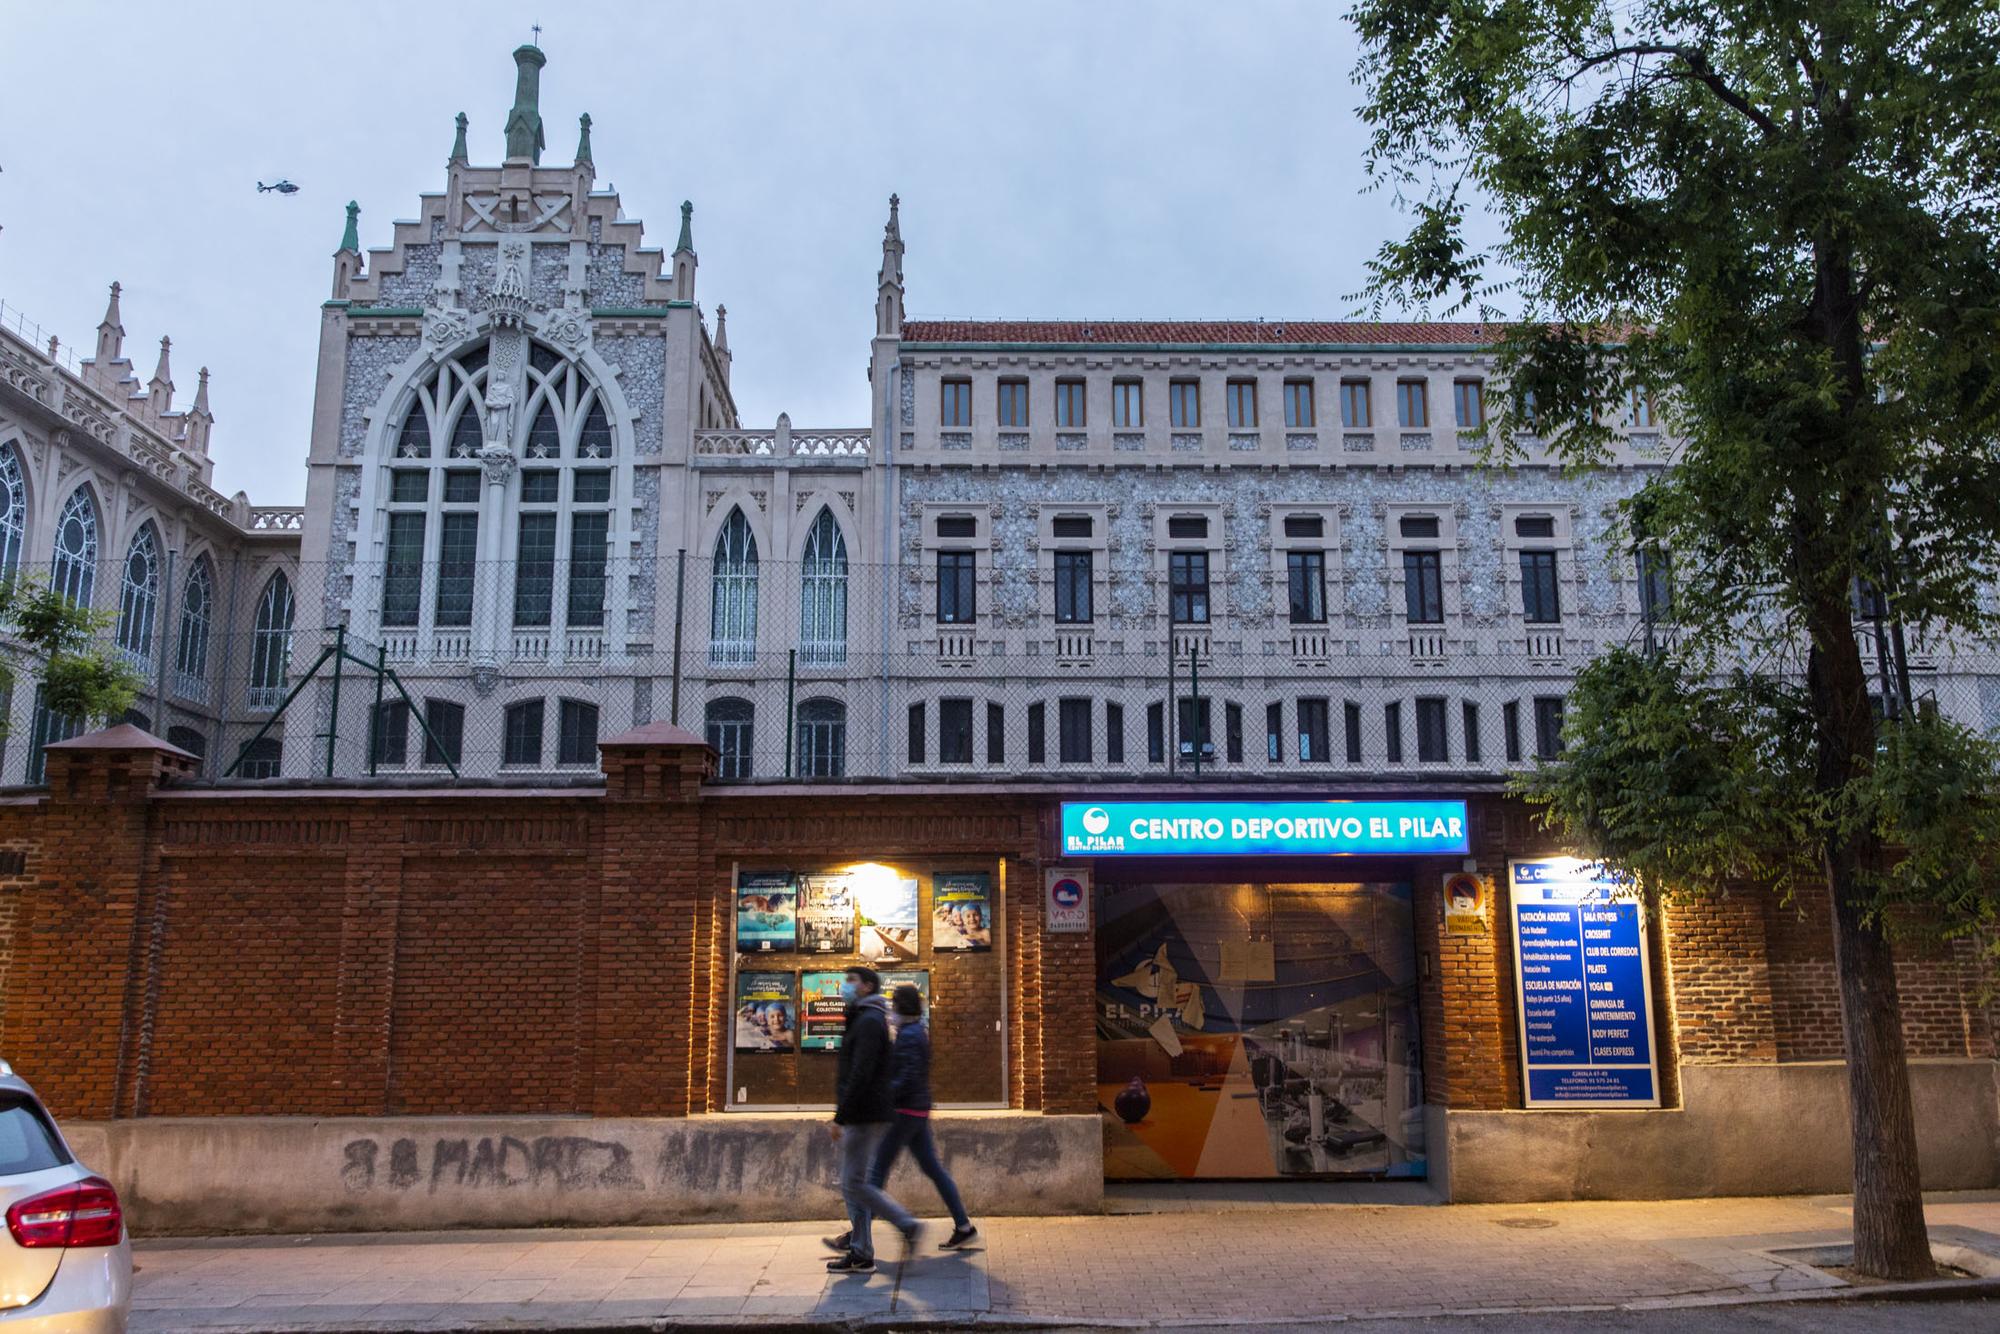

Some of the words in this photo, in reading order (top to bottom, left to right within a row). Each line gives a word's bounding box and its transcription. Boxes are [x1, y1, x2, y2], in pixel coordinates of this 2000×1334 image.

[1129, 818, 1224, 840] CENTRO
[1232, 817, 1362, 840] DEPORTIVO
[1370, 818, 1394, 839] EL
[1400, 817, 1463, 838] PILAR
[1067, 836, 1083, 847] EL
[1087, 836, 1124, 847] PILAR
[1520, 911, 1546, 922] NATACIÓN
[1547, 912, 1570, 922] ADULTOS
[1584, 912, 1597, 922] SALA
[1586, 947, 1599, 956] CLUB
[1600, 947, 1610, 956] DEL
[1610, 947, 1638, 956] CORREDOR
[1587, 965, 1607, 974] PILATES
[1525, 981, 1547, 990] ESCUELA
[1548, 981, 1555, 990] DE
[1556, 979, 1581, 990] NATACIÓN
[1589, 982, 1604, 991] YOGA
[1590, 1000, 1616, 1008] GIMNASIA
[1618, 1000, 1624, 1008] DE
[1106, 1004, 1130, 1018] EL
[1140, 1004, 1184, 1018] PILA
[1591, 1012, 1636, 1020] MANTENIMIENTO
[1592, 1030, 1606, 1038] BODY
[1608, 1029, 1629, 1038] PERFECT
[1594, 1047, 1612, 1056] CLASES
[1613, 1047, 1634, 1056] EXPRESS
